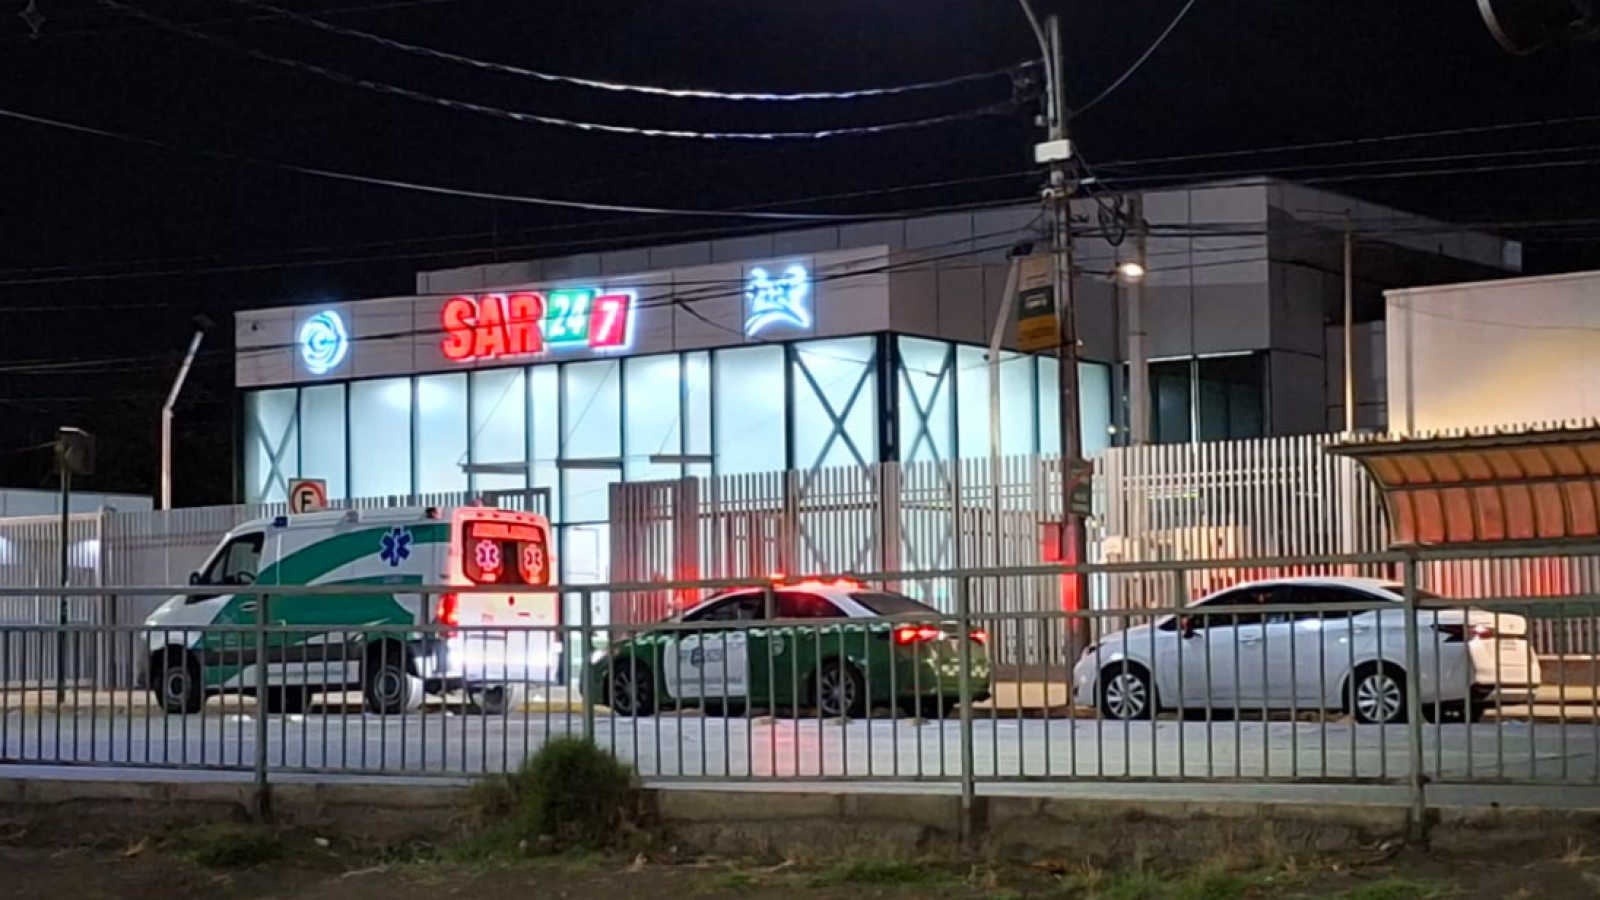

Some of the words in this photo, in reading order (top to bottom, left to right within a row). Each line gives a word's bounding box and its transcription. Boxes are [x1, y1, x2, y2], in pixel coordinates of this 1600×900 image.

[442, 293, 543, 361] SAR
[551, 294, 590, 336] 24
[596, 300, 619, 343] 7
